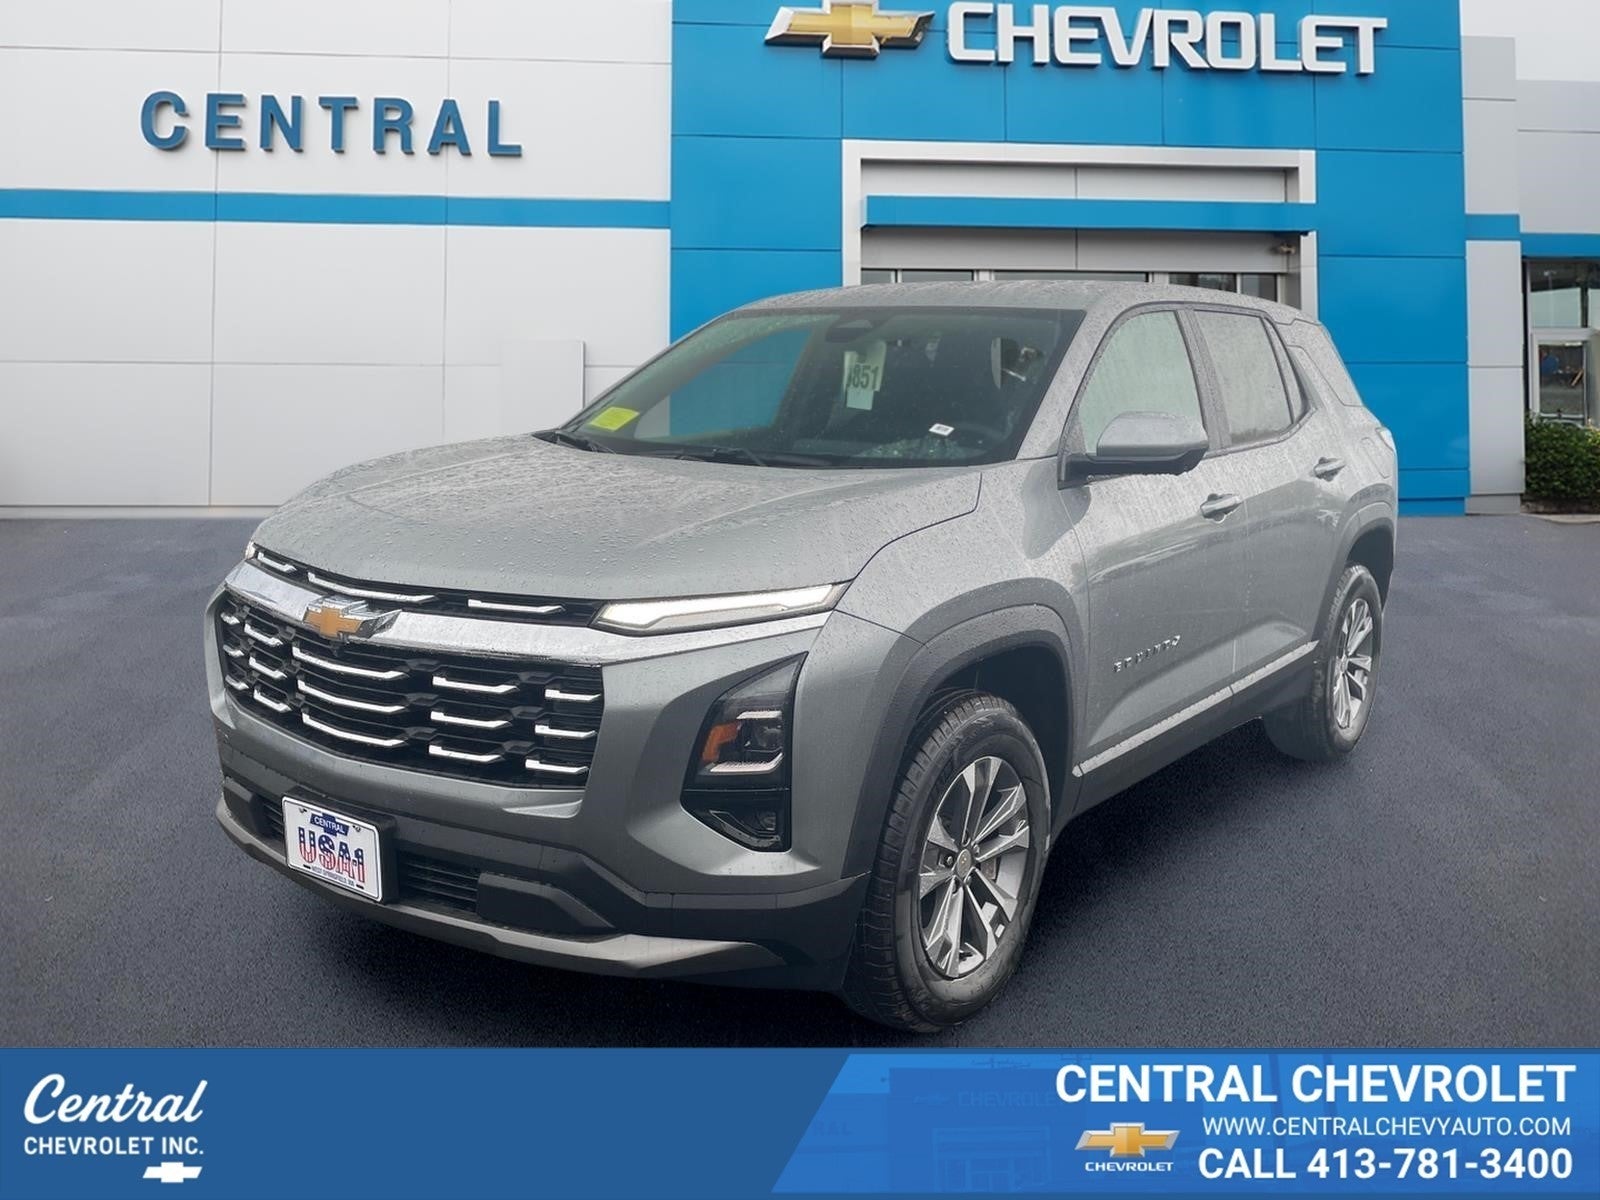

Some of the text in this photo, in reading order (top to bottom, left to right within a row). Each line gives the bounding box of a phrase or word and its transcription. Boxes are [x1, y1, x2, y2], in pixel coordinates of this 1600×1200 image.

[947, 1, 1388, 75] CHEVROLET
[141, 90, 523, 157] CENTRAL
[313, 816, 346, 835] CENTRAL
